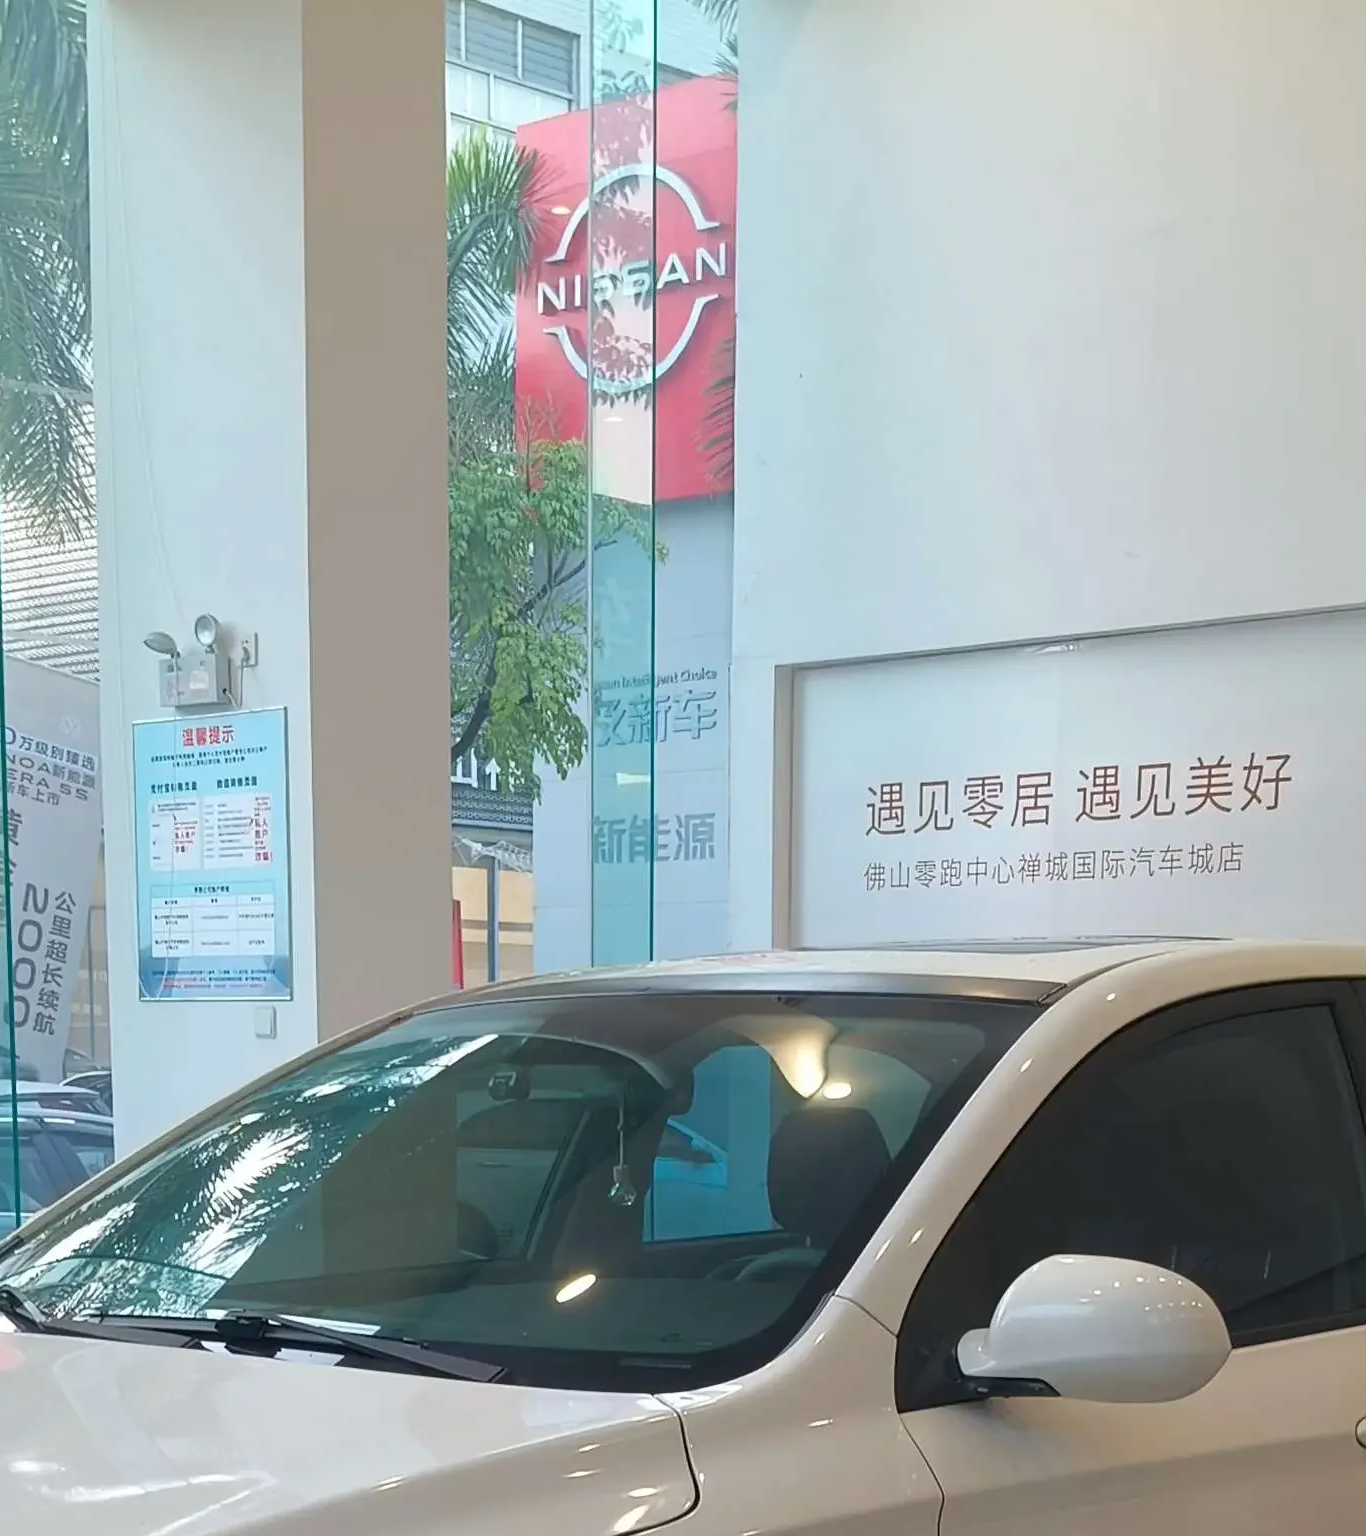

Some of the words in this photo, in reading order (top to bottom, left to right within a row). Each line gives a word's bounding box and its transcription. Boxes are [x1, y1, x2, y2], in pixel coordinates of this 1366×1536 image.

[537, 241, 728, 315] NISSAN
[182, 724, 235, 748] 温馨提示
[864, 771, 1054, 838] 遇见零居
[1074, 752, 1293, 822] 遇见美好
[592, 812, 717, 865] 新能源
[863, 842, 1245, 891] 佛山零跑中心禅城国际汽车城店
[3, 882, 50, 1028] 2000
[33, 891, 77, 1036] 公里超长续航
